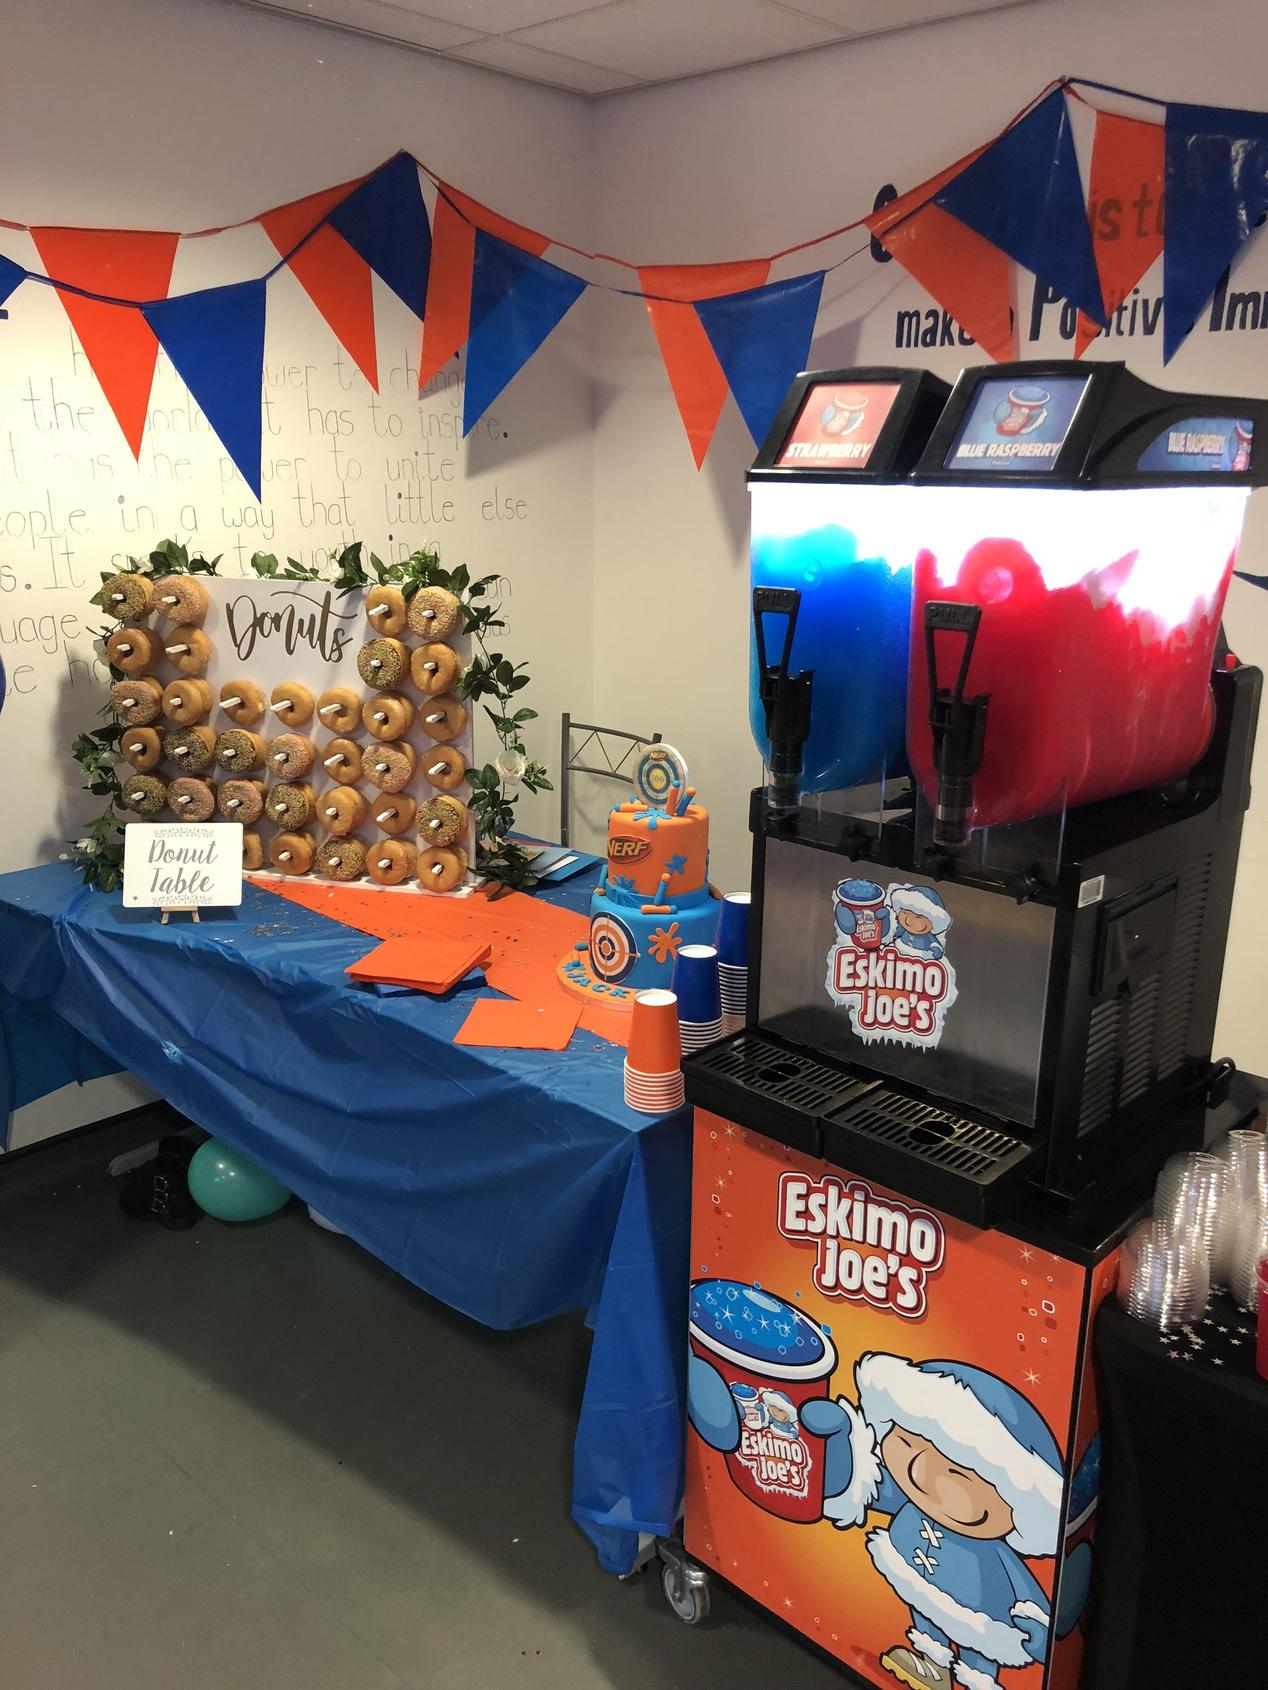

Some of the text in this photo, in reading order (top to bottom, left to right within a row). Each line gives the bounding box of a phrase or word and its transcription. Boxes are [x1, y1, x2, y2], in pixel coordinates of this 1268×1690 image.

[22, 376, 95, 435] the
[305, 388, 354, 436] has
[368, 392, 402, 437] to
[329, 436, 362, 482] to
[386, 439, 455, 483] unite
[784, 442, 872, 459] STRAWBERRY
[956, 442, 1062, 458] BLUE RASPBERRY
[118, 494, 156, 533] in
[180, 505, 198, 532] a
[221, 506, 275, 541] way
[292, 480, 356, 528] that
[384, 483, 456, 525] little
[481, 486, 528, 521] else
[40, 534, 86, 590] It
[226, 591, 358, 664] Donuts
[928, 605, 971, 626] PULL
[148, 838, 219, 865] Donut
[608, 839, 651, 857] NERF
[149, 866, 215, 895] Table
[839, 951, 942, 997] Eskimo
[785, 1181, 937, 1263] Eskimo
[741, 1430, 803, 1464] Eskimo
